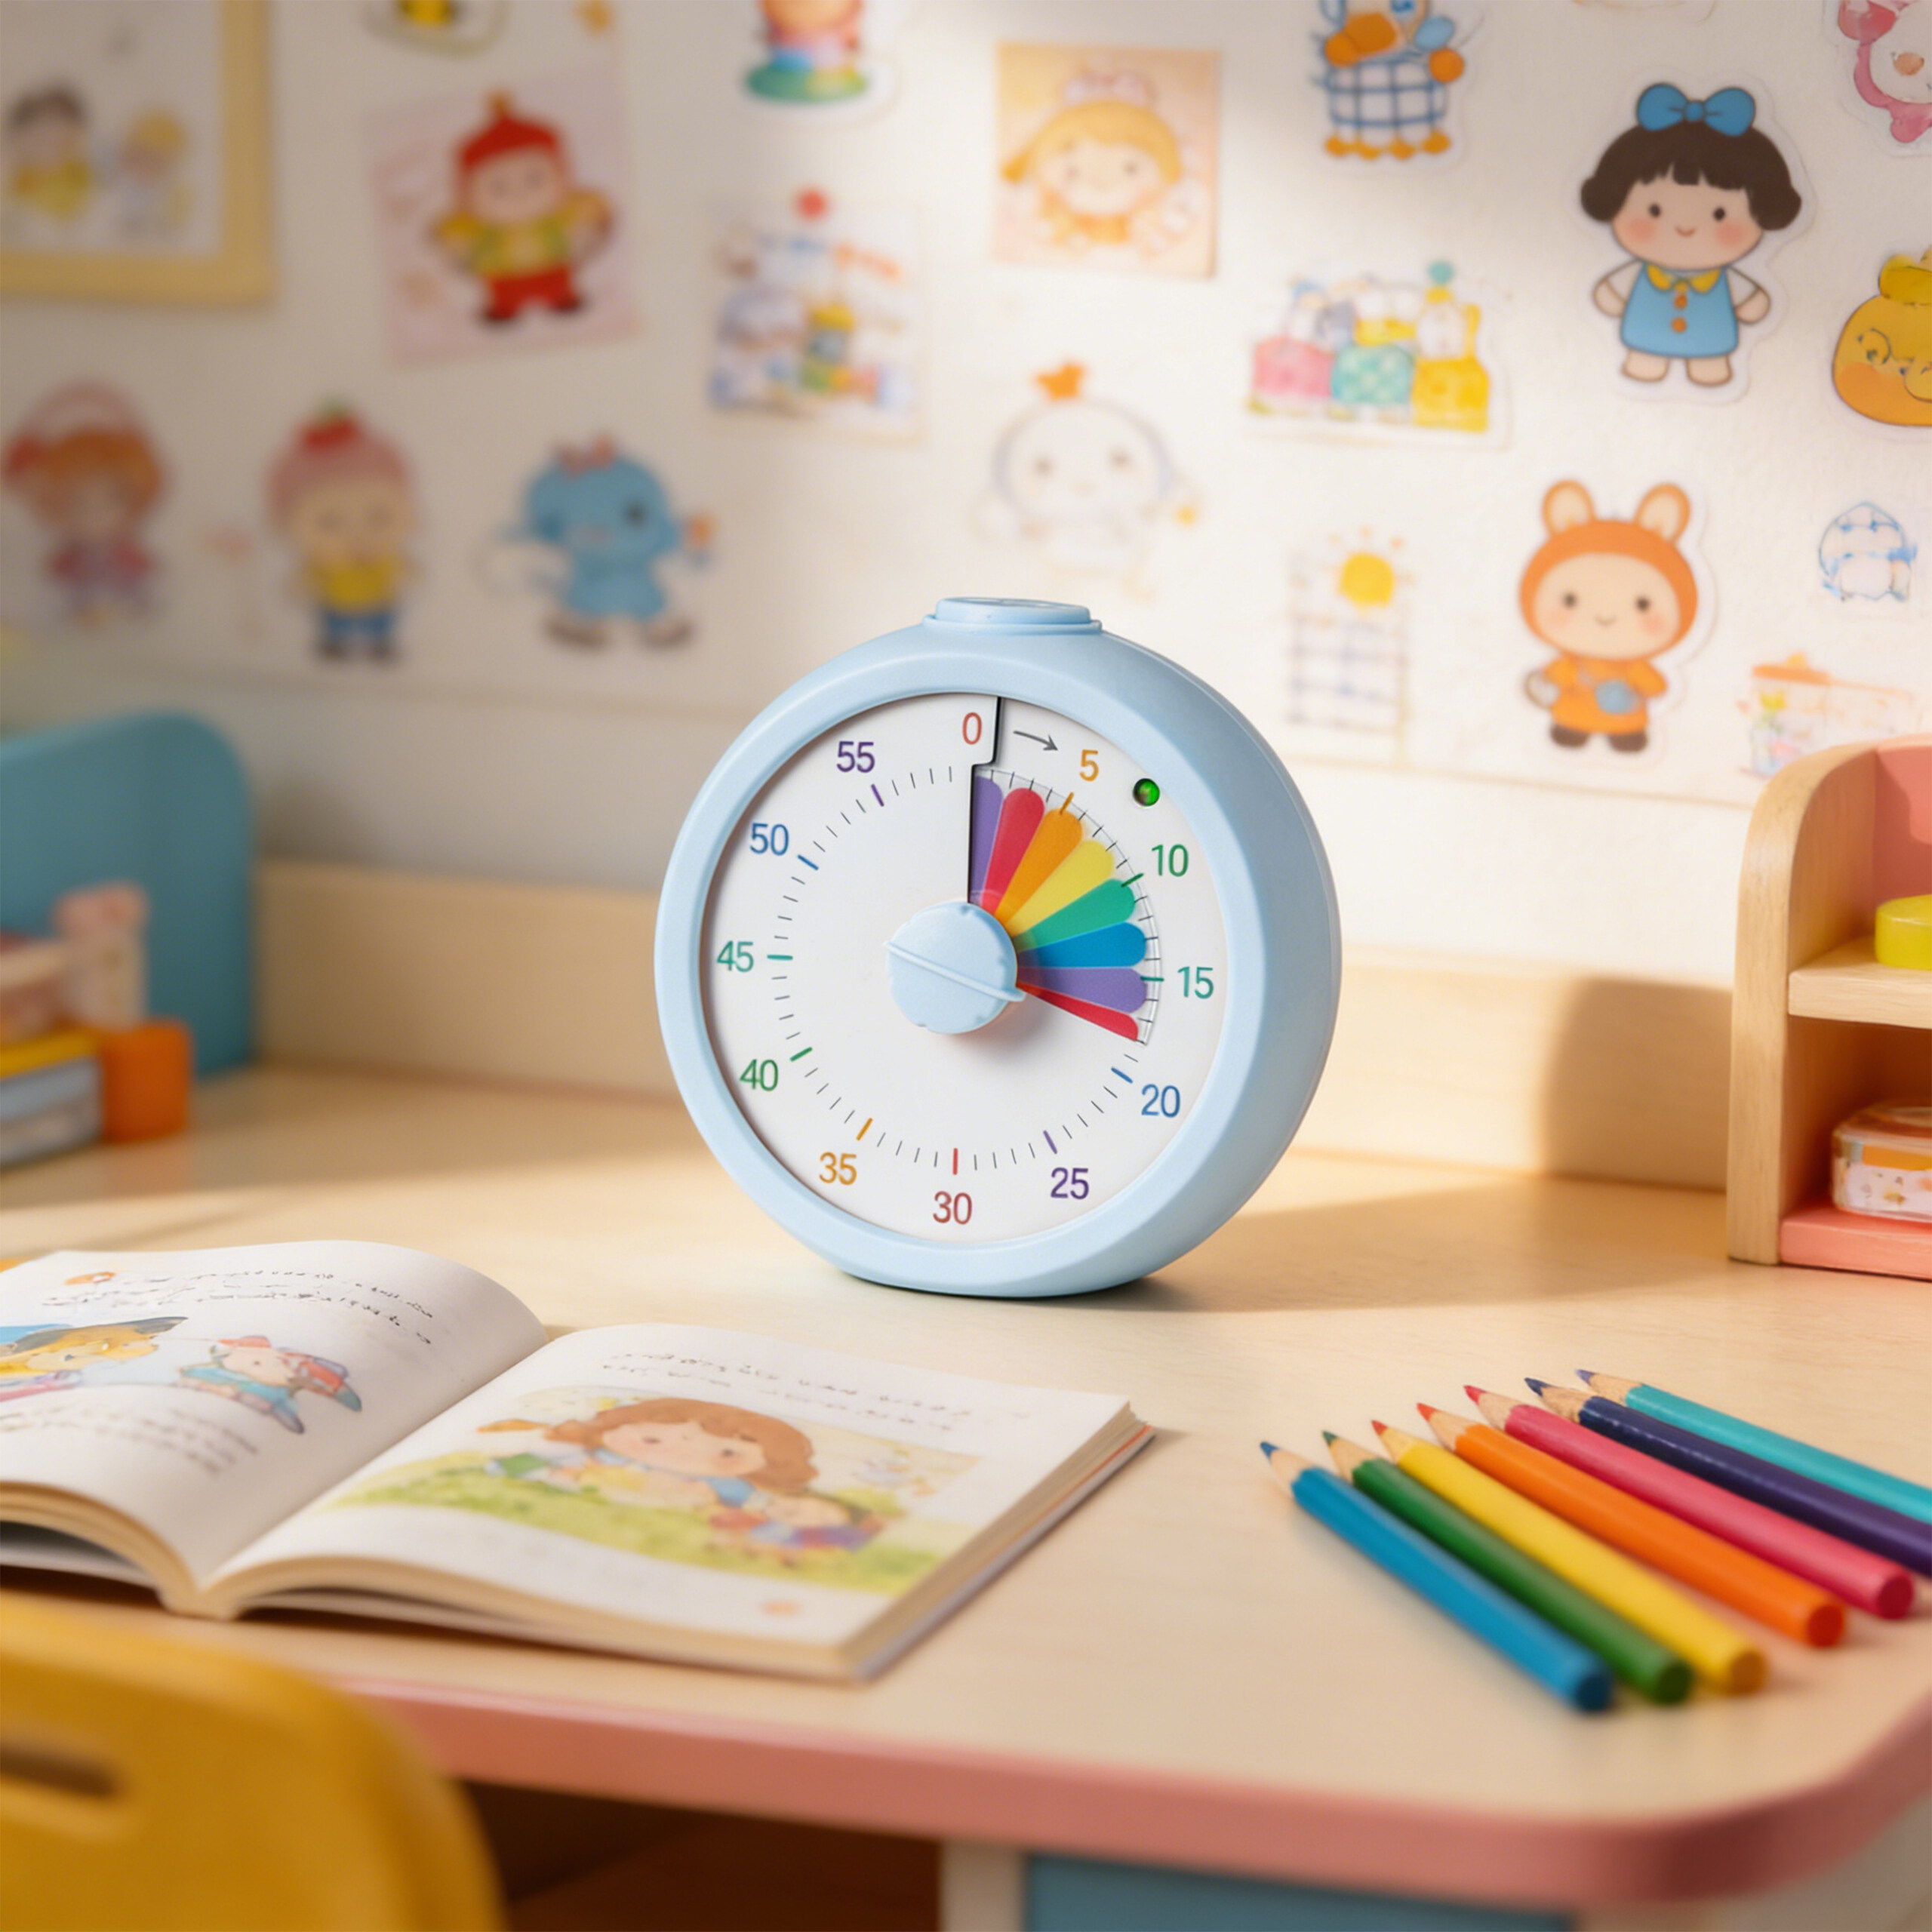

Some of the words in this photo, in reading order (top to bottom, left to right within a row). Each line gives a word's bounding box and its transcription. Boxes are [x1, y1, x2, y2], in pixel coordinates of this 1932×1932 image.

[961, 712, 983, 746] 0
[836, 740, 875, 774] 55
[1079, 749, 1100, 783] 5
[749, 822, 789, 857] 50
[1151, 843, 1189, 878] 10
[716, 940, 754, 974] 45
[1177, 965, 1214, 1000] 15
[739, 1059, 779, 1092] 40
[1141, 1083, 1181, 1118] 20
[819, 1151, 857, 1186] 35
[1050, 1167, 1090, 1200] 25
[932, 1190, 973, 1226] 30
